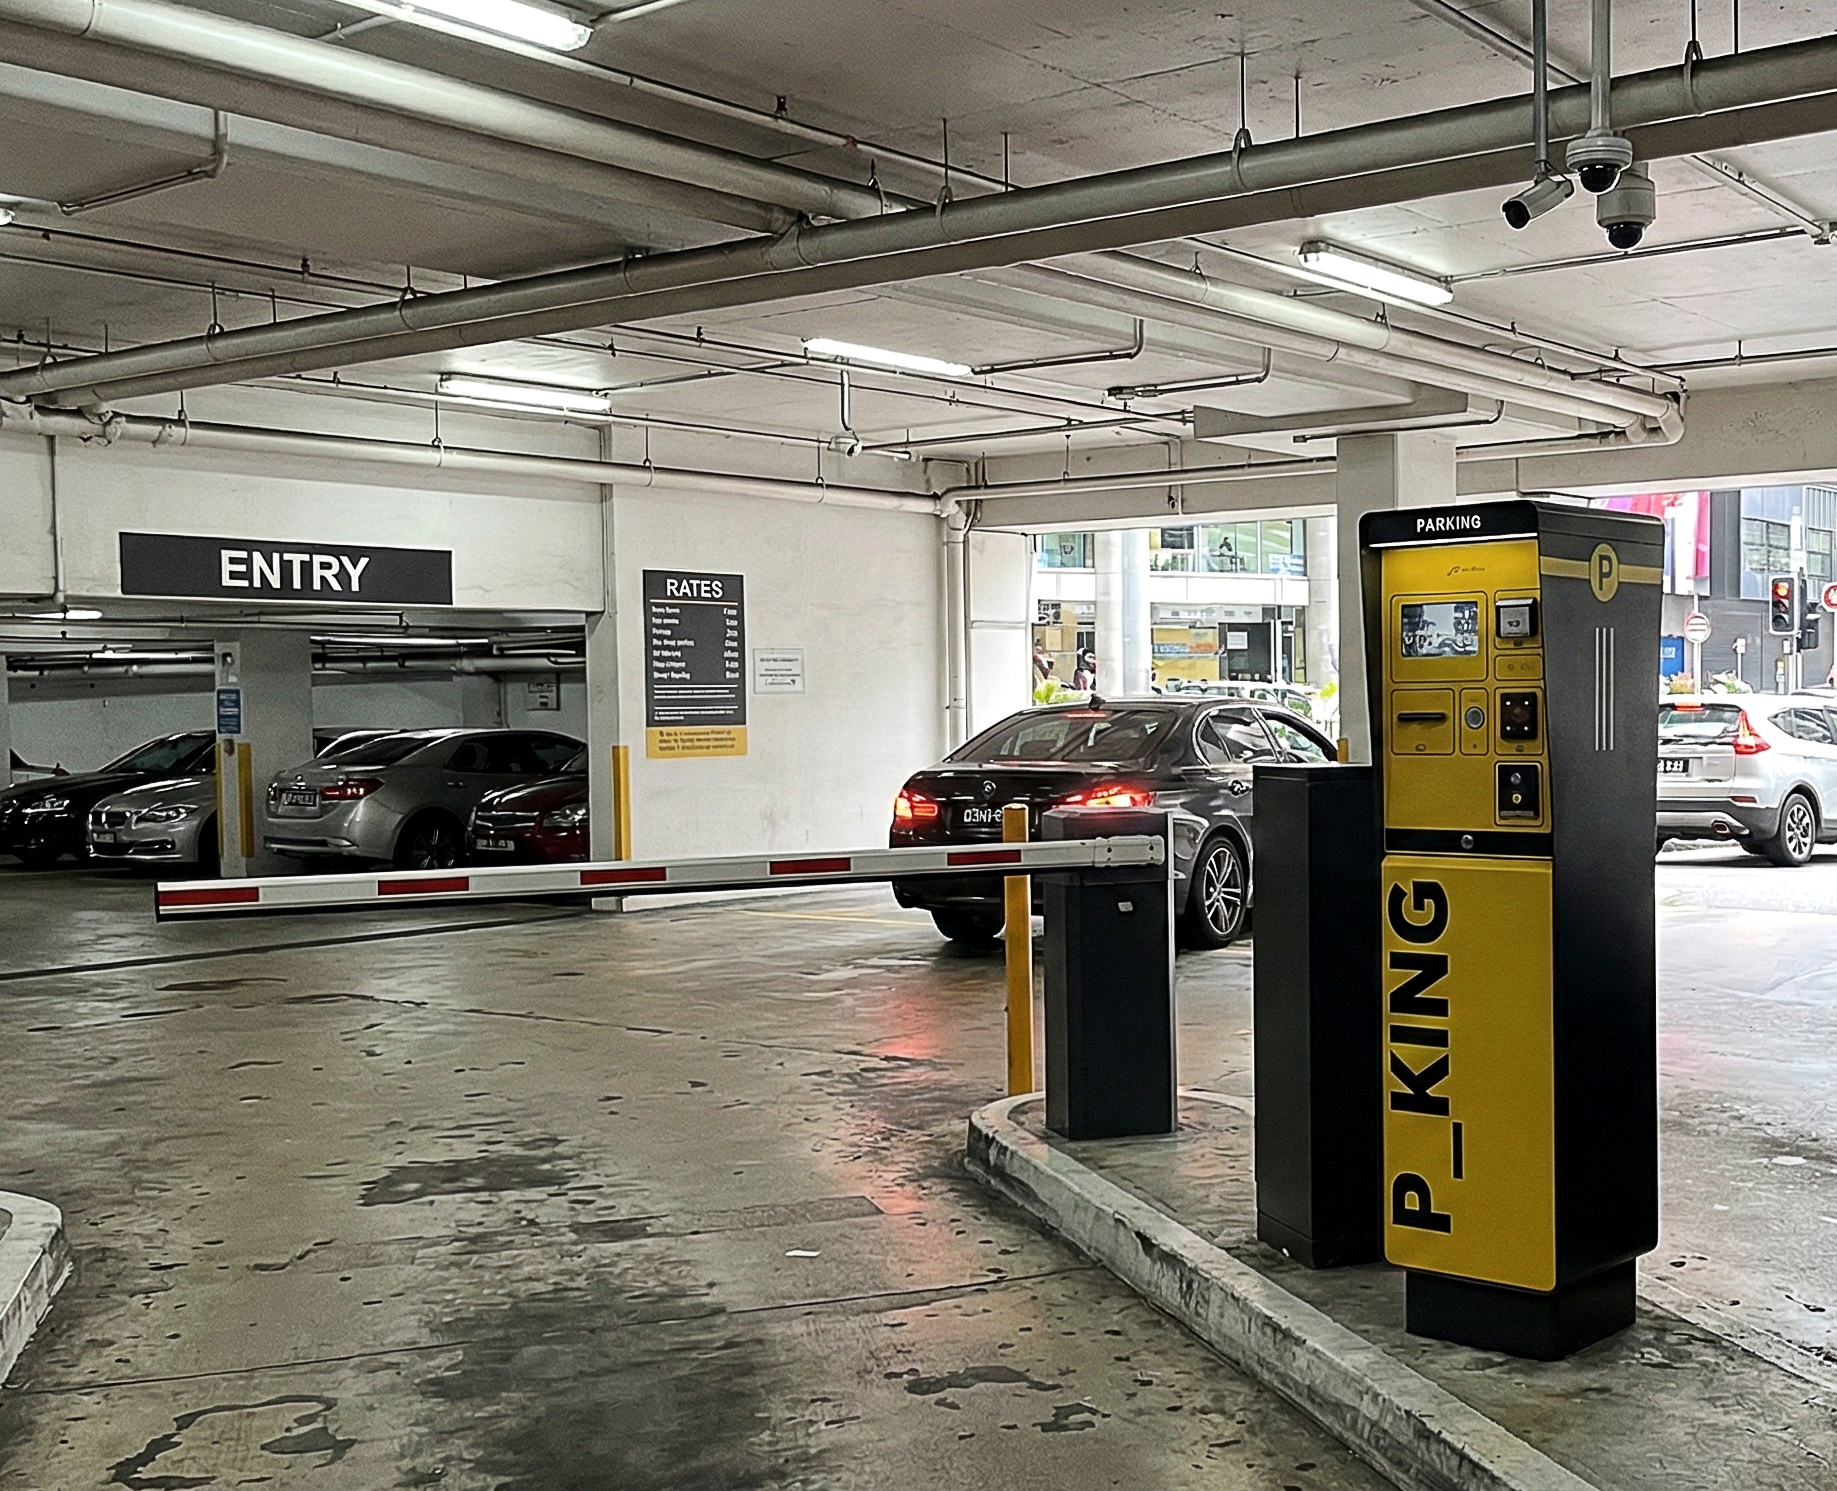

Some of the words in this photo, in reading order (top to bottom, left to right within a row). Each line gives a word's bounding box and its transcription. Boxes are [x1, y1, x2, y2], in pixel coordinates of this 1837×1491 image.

[1416, 515, 1482, 533] PARKING
[220, 549, 371, 592] ENTRY
[1598, 554, 1613, 591] P
[666, 578, 723, 599] RATES
